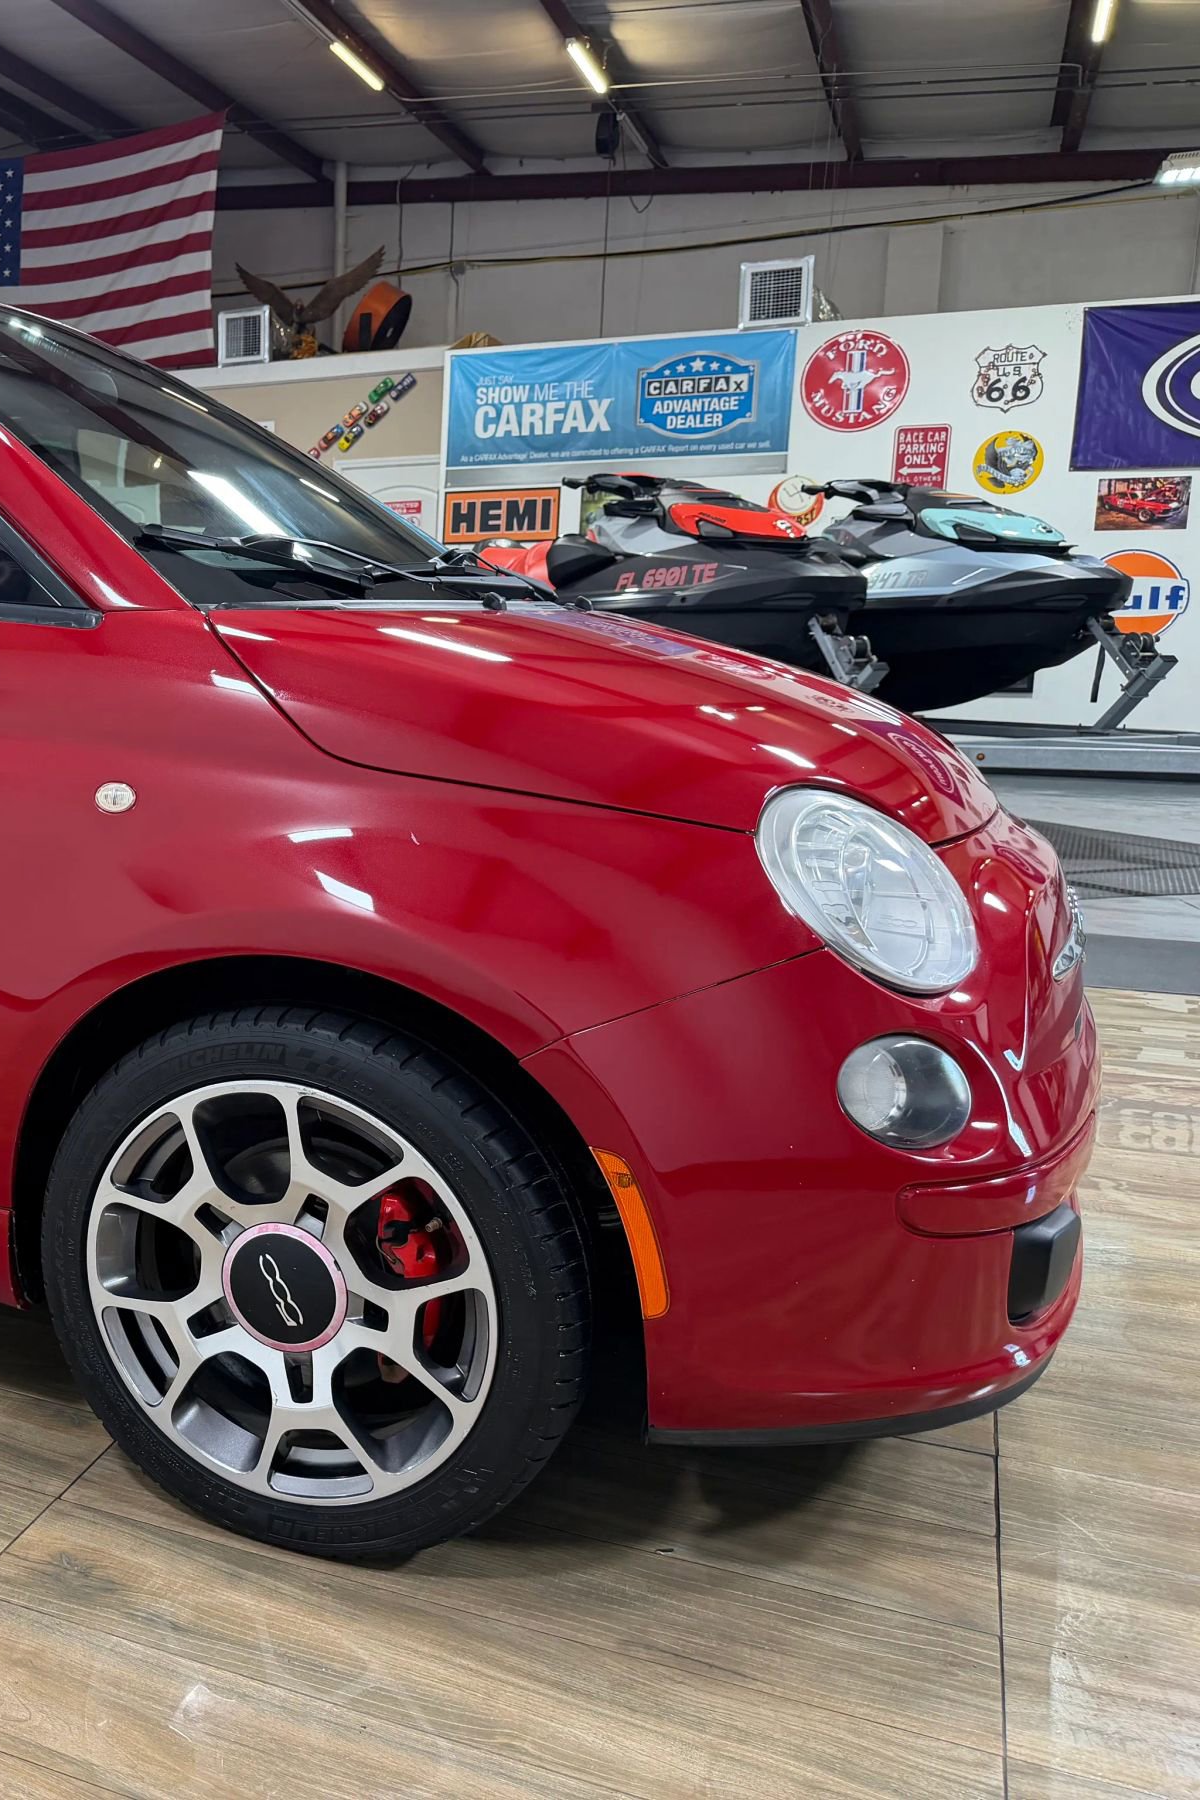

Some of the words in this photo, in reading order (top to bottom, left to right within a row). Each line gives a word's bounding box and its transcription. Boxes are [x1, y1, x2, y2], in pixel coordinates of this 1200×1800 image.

[826, 339, 888, 360] FORD
[993, 351, 1027, 364] ROUTE
[478, 375, 499, 386] JUST
[500, 374, 514, 385] SAY
[648, 376, 745, 395] CARFAX
[986, 376, 1030, 402] 66
[476, 384, 530, 405] SHOW
[534, 382, 558, 401] ME
[565, 380, 594, 400] THE
[811, 386, 897, 423] MUSTANG
[474, 398, 612, 438] CARFAX
[666, 414, 723, 429] DEALER
[899, 432, 925, 443] RACE
[927, 431, 947, 442] CAR
[898, 443, 945, 454] PARKING
[904, 454, 937, 465] ONLY
[450, 498, 554, 534] HEMI
[615, 572, 637, 592] FL
[642, 565, 686, 587] 6901
[692, 562, 719, 587] TE
[1122, 586, 1186, 611] ulf
